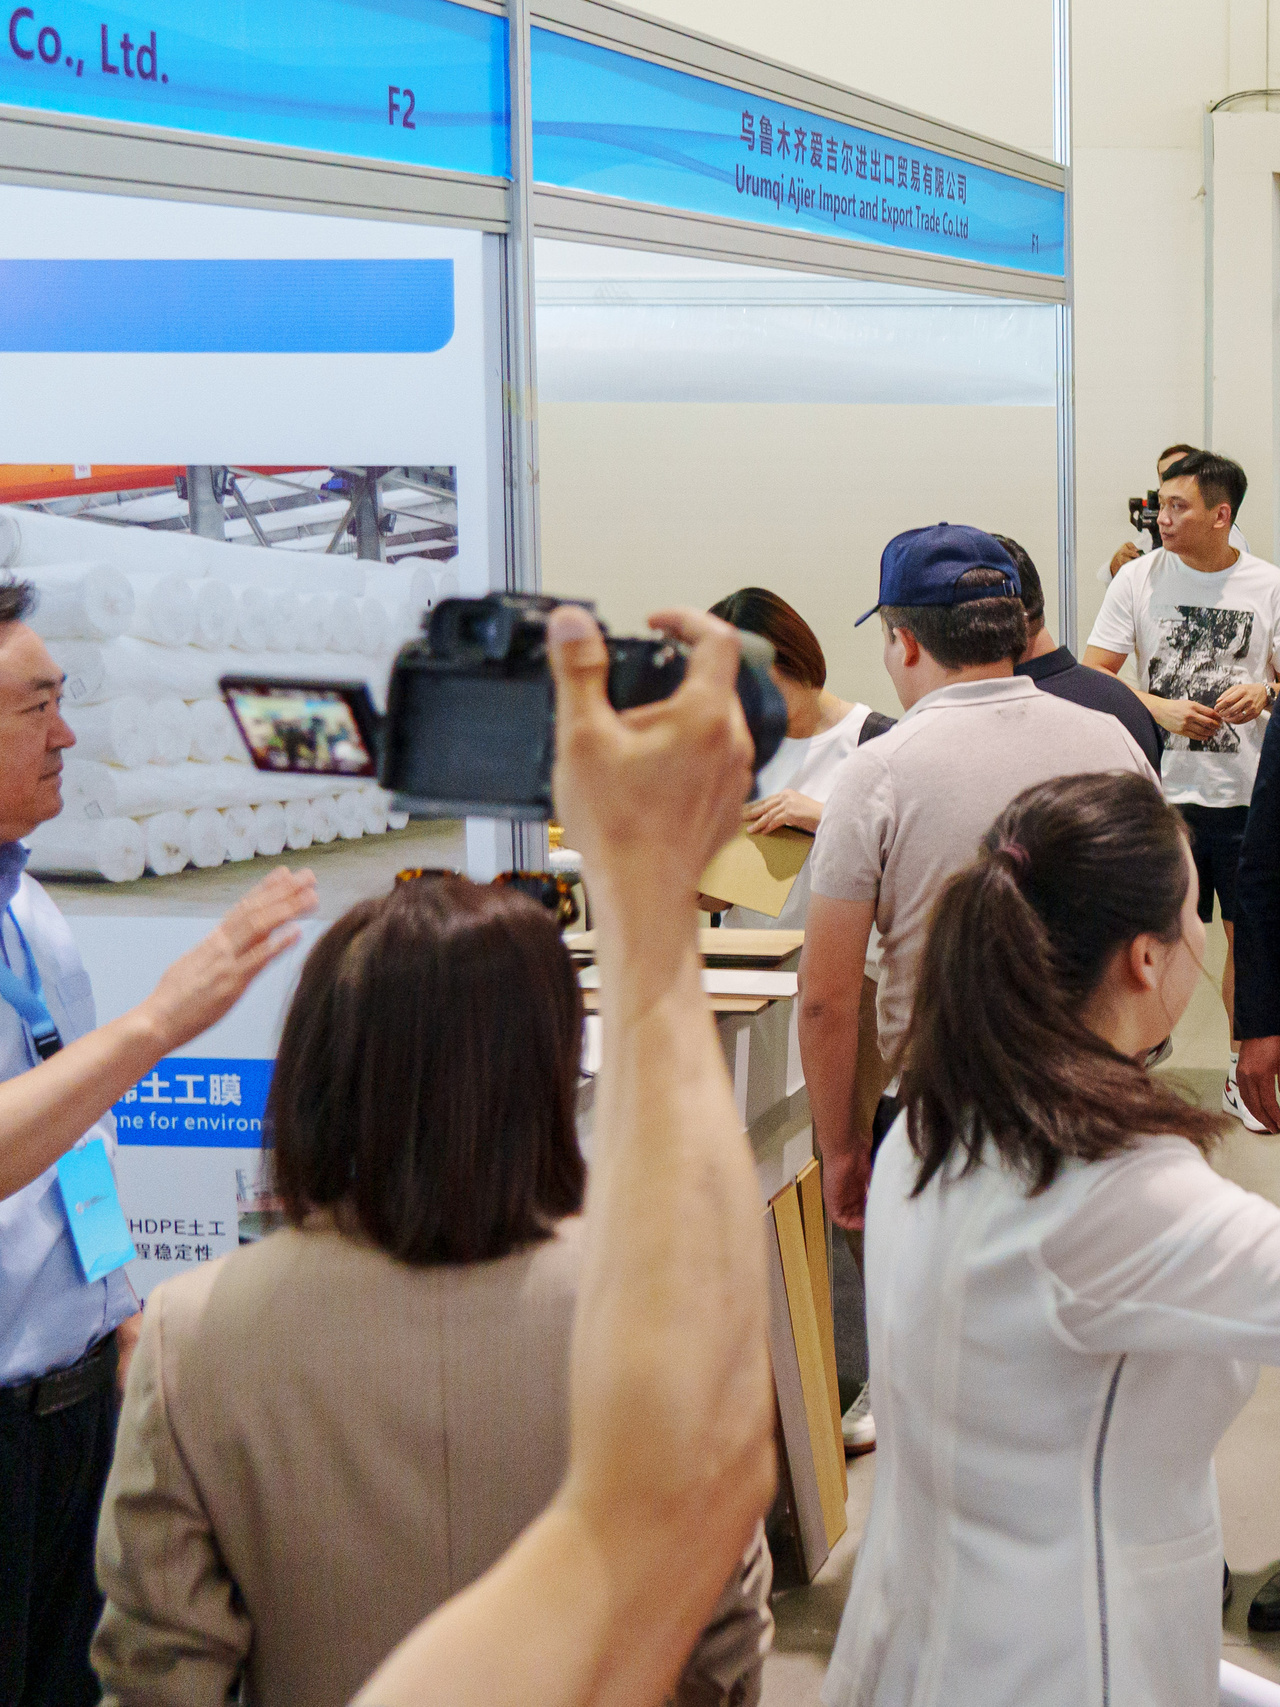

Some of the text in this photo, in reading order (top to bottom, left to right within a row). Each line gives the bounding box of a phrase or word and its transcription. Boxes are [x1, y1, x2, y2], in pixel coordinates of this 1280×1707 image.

[8, 7, 169, 84] Co., Ltd.
[387, 85, 417, 130] F2
[739, 109, 968, 205] 乌鲁木齐爱吉尔进出口贸易有限公司
[735, 164, 969, 240] Urumqi Ajier Import and Export Trade Co.Ltd
[1031, 233, 1039, 254] F1
[119, 1071, 242, 1106] 土工膜
[150, 1110, 178, 1130] for
[184, 1112, 262, 1131] environ
